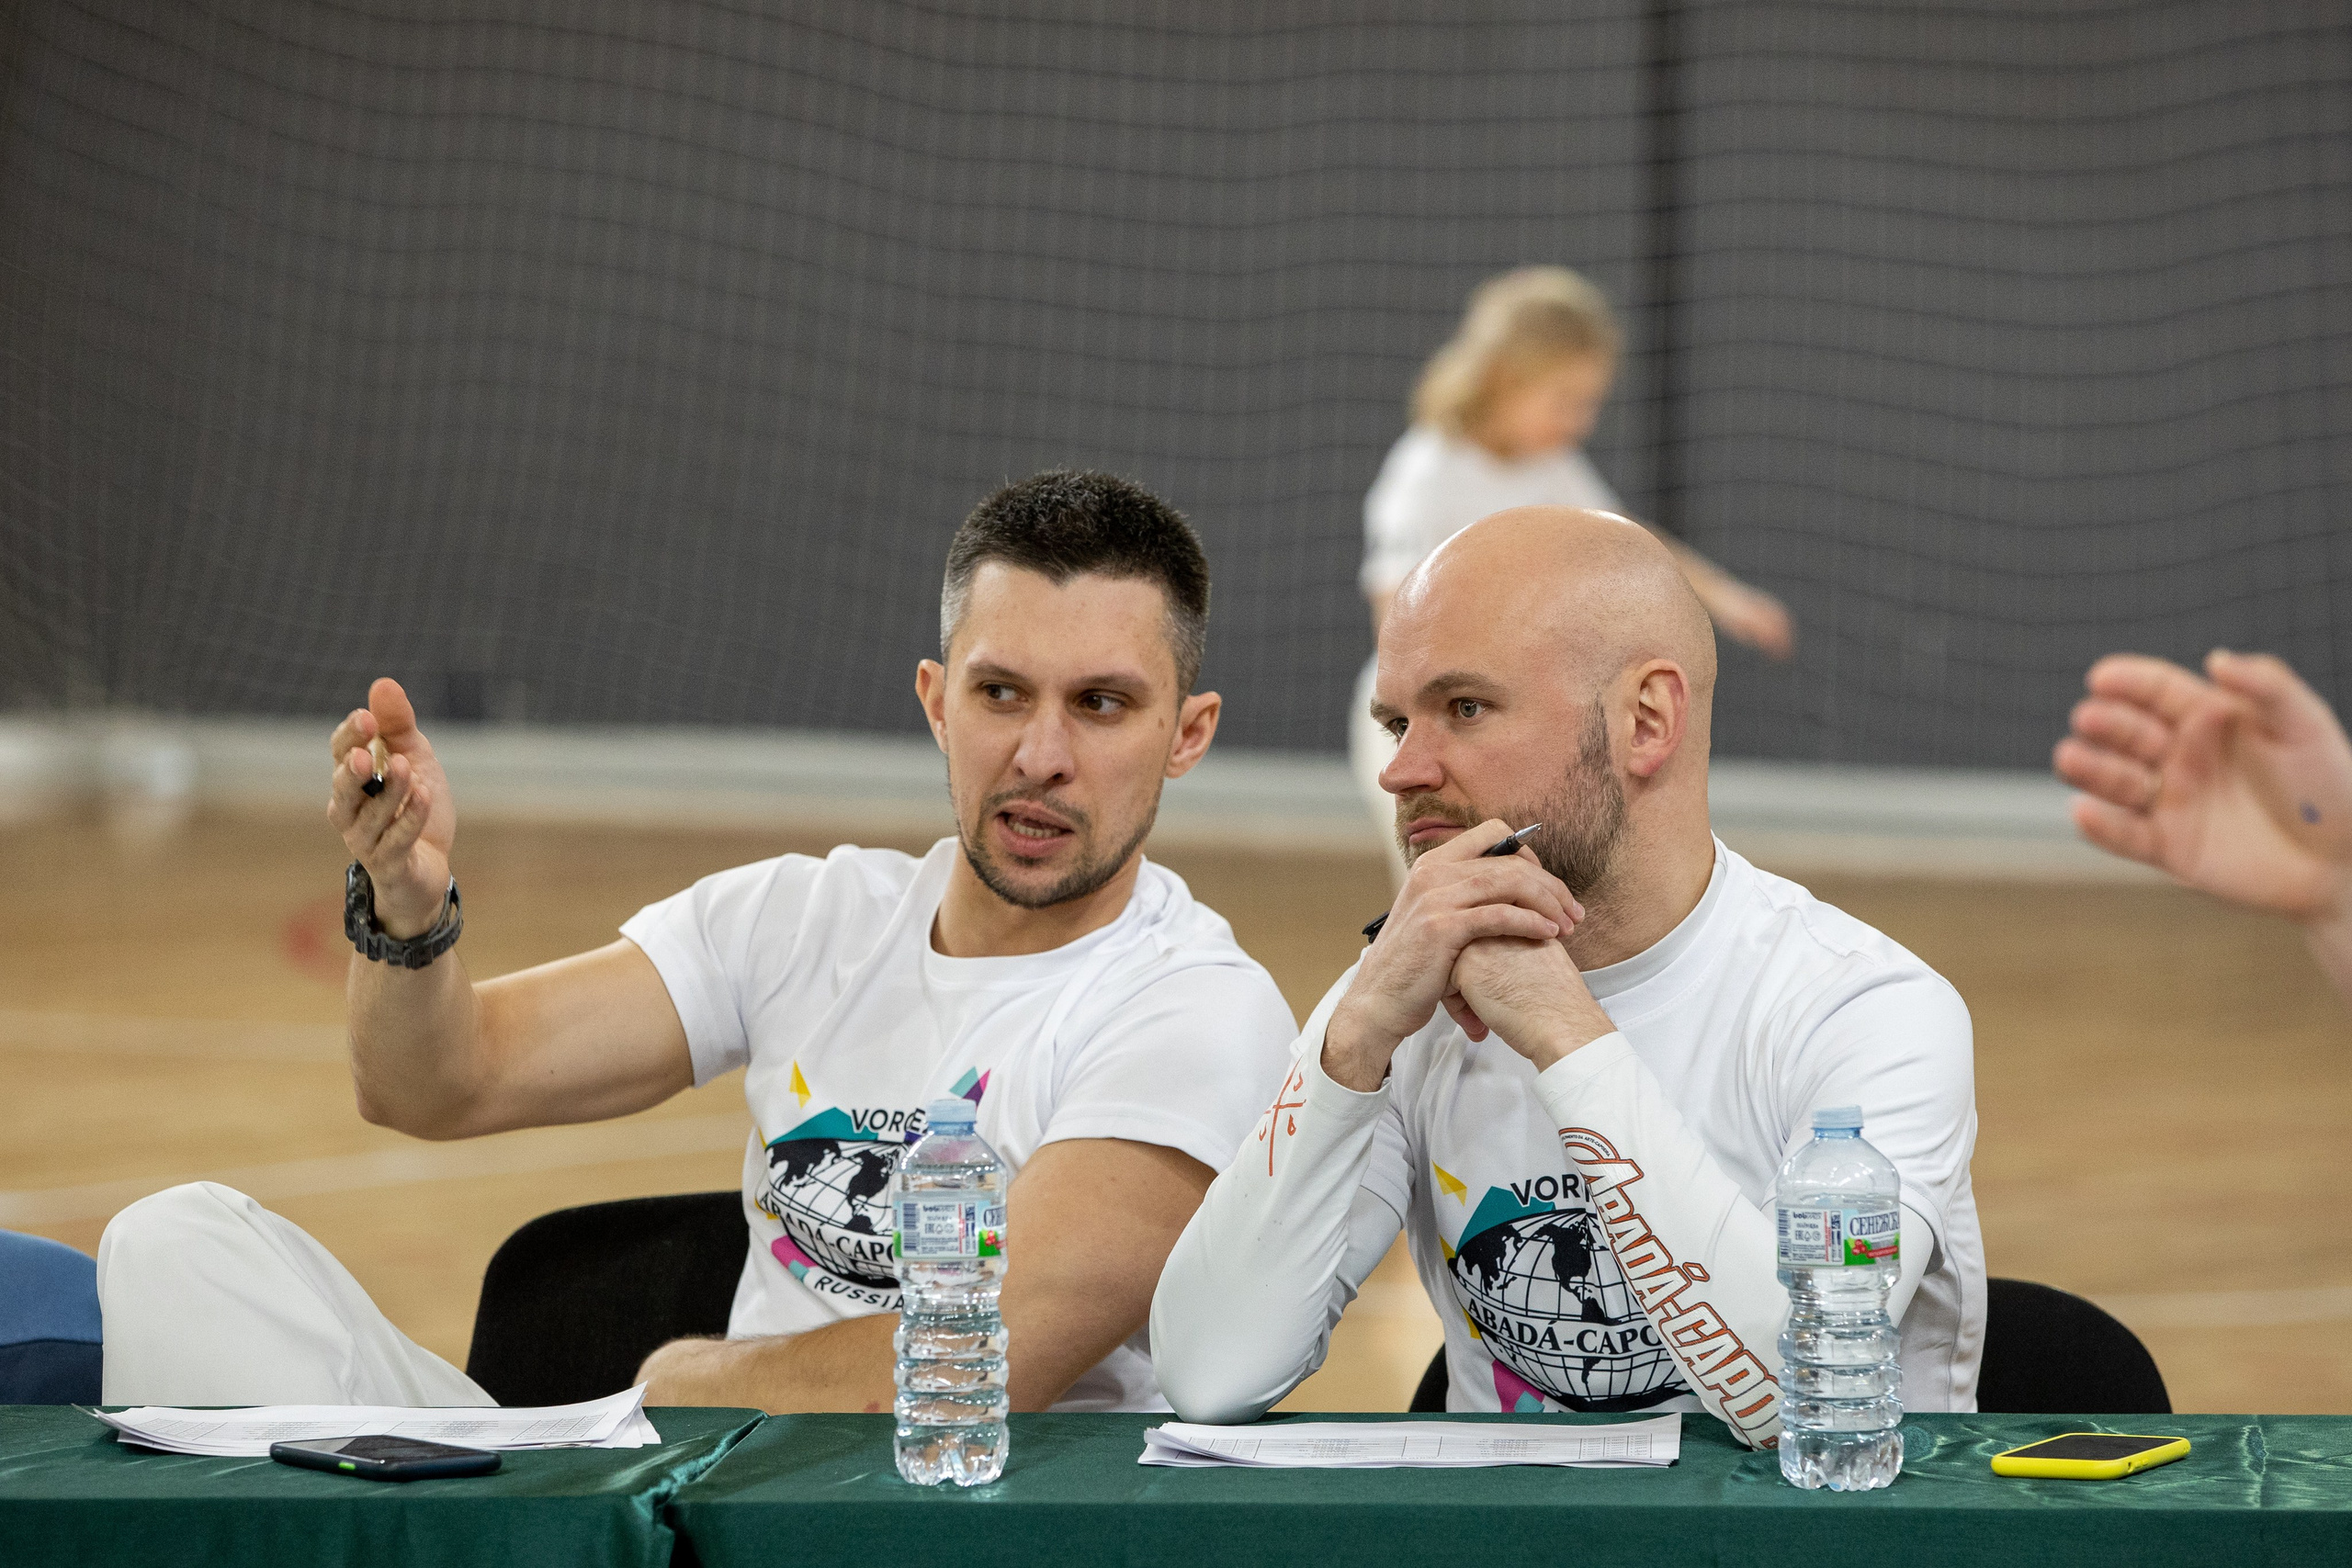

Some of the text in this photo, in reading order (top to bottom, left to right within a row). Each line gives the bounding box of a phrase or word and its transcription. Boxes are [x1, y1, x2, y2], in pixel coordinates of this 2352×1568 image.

[814, 1276, 905, 1311] RUSSIA
[1565, 1153, 1781, 1450] ABADÁ-CAPO
[1468, 1297, 1663, 1355] ABADÁ-CAPO
